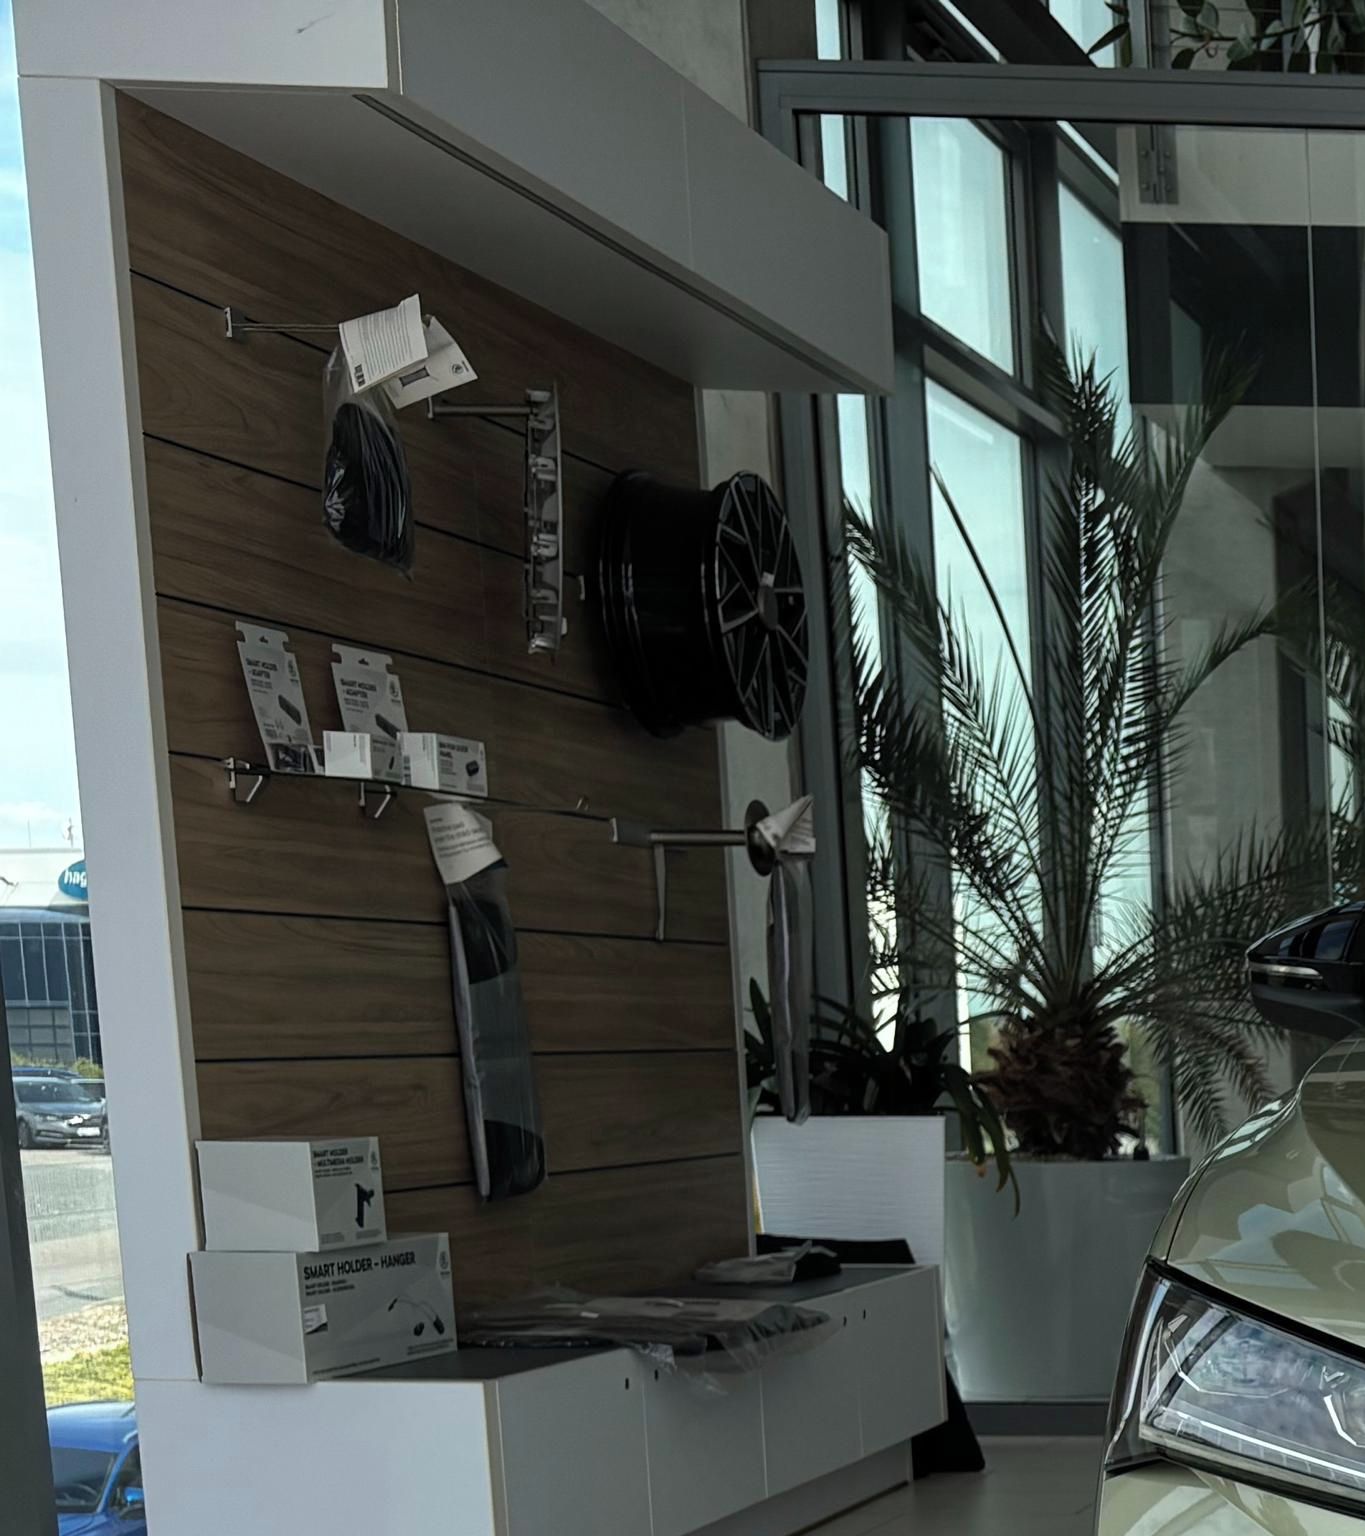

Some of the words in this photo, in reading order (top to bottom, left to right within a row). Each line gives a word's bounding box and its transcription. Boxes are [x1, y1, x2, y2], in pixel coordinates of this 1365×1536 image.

[303, 1262, 335, 1281] SMART
[337, 1257, 373, 1276] HOLDER
[380, 1251, 416, 1269] HANGER
